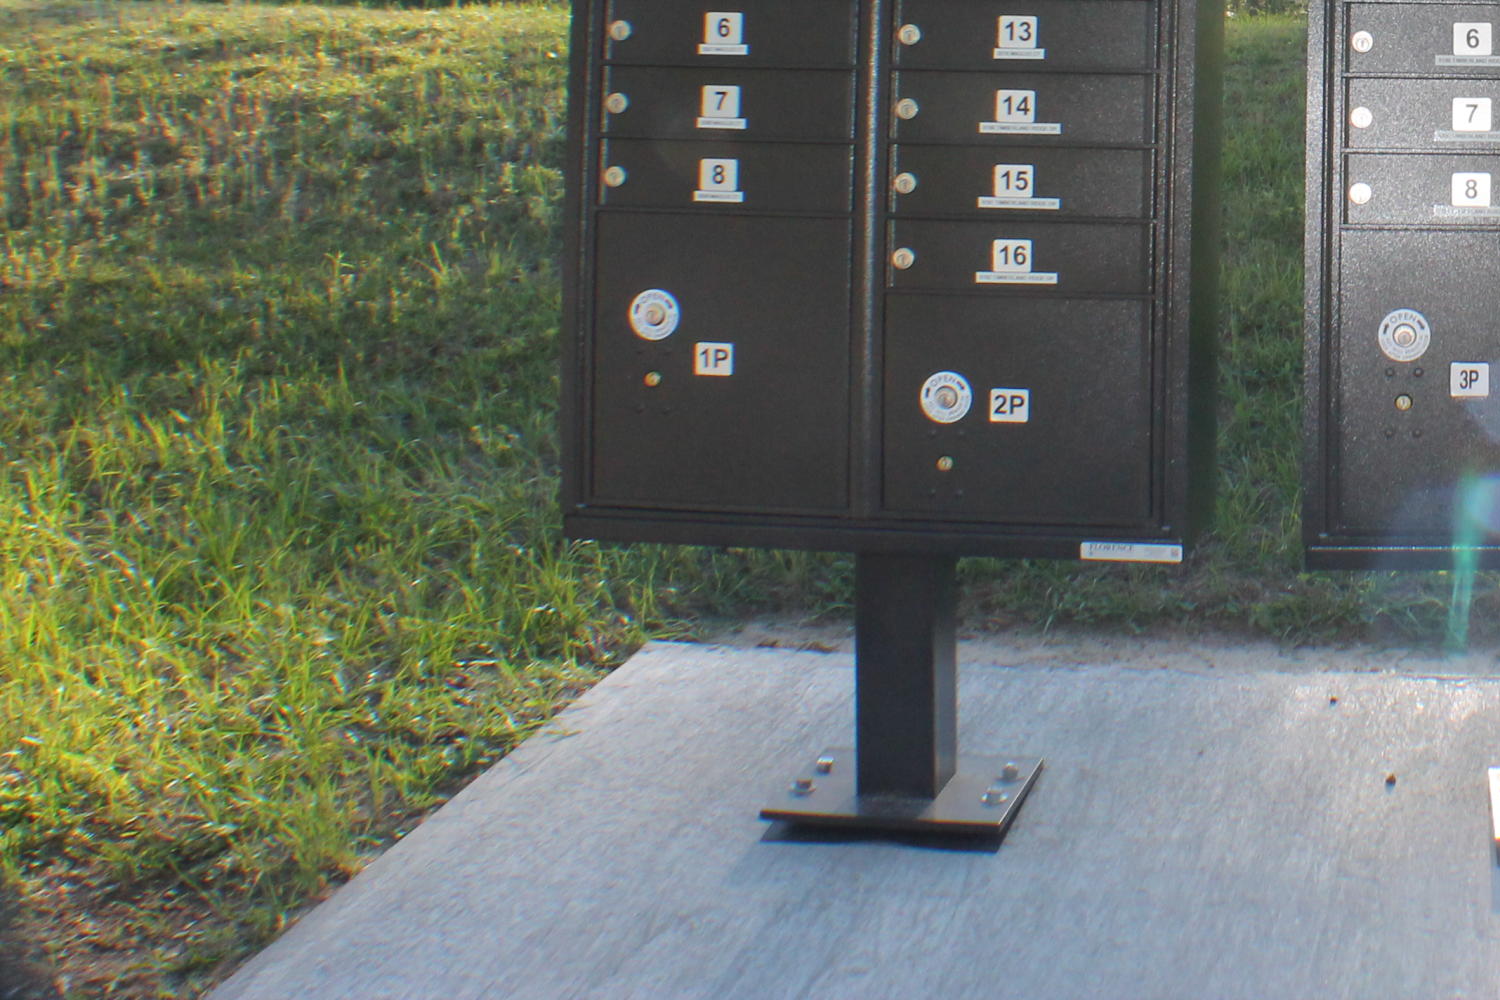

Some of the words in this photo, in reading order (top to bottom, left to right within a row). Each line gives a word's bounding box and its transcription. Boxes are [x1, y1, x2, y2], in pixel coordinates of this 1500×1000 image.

[717, 17, 731, 38] 6
[1005, 21, 1032, 42] 13
[1466, 28, 1480, 49] 6
[714, 91, 728, 111] 7
[1003, 95, 1030, 116] 14
[1465, 103, 1478, 123] 7
[712, 164, 725, 185] 8
[1001, 170, 1029, 191] 15
[1464, 179, 1478, 200] 8
[999, 245, 1027, 266] 16
[1390, 312, 1417, 324] OPEN
[701, 348, 729, 368] 1P
[1459, 369, 1480, 390] 3P
[993, 394, 1025, 415] 2P
